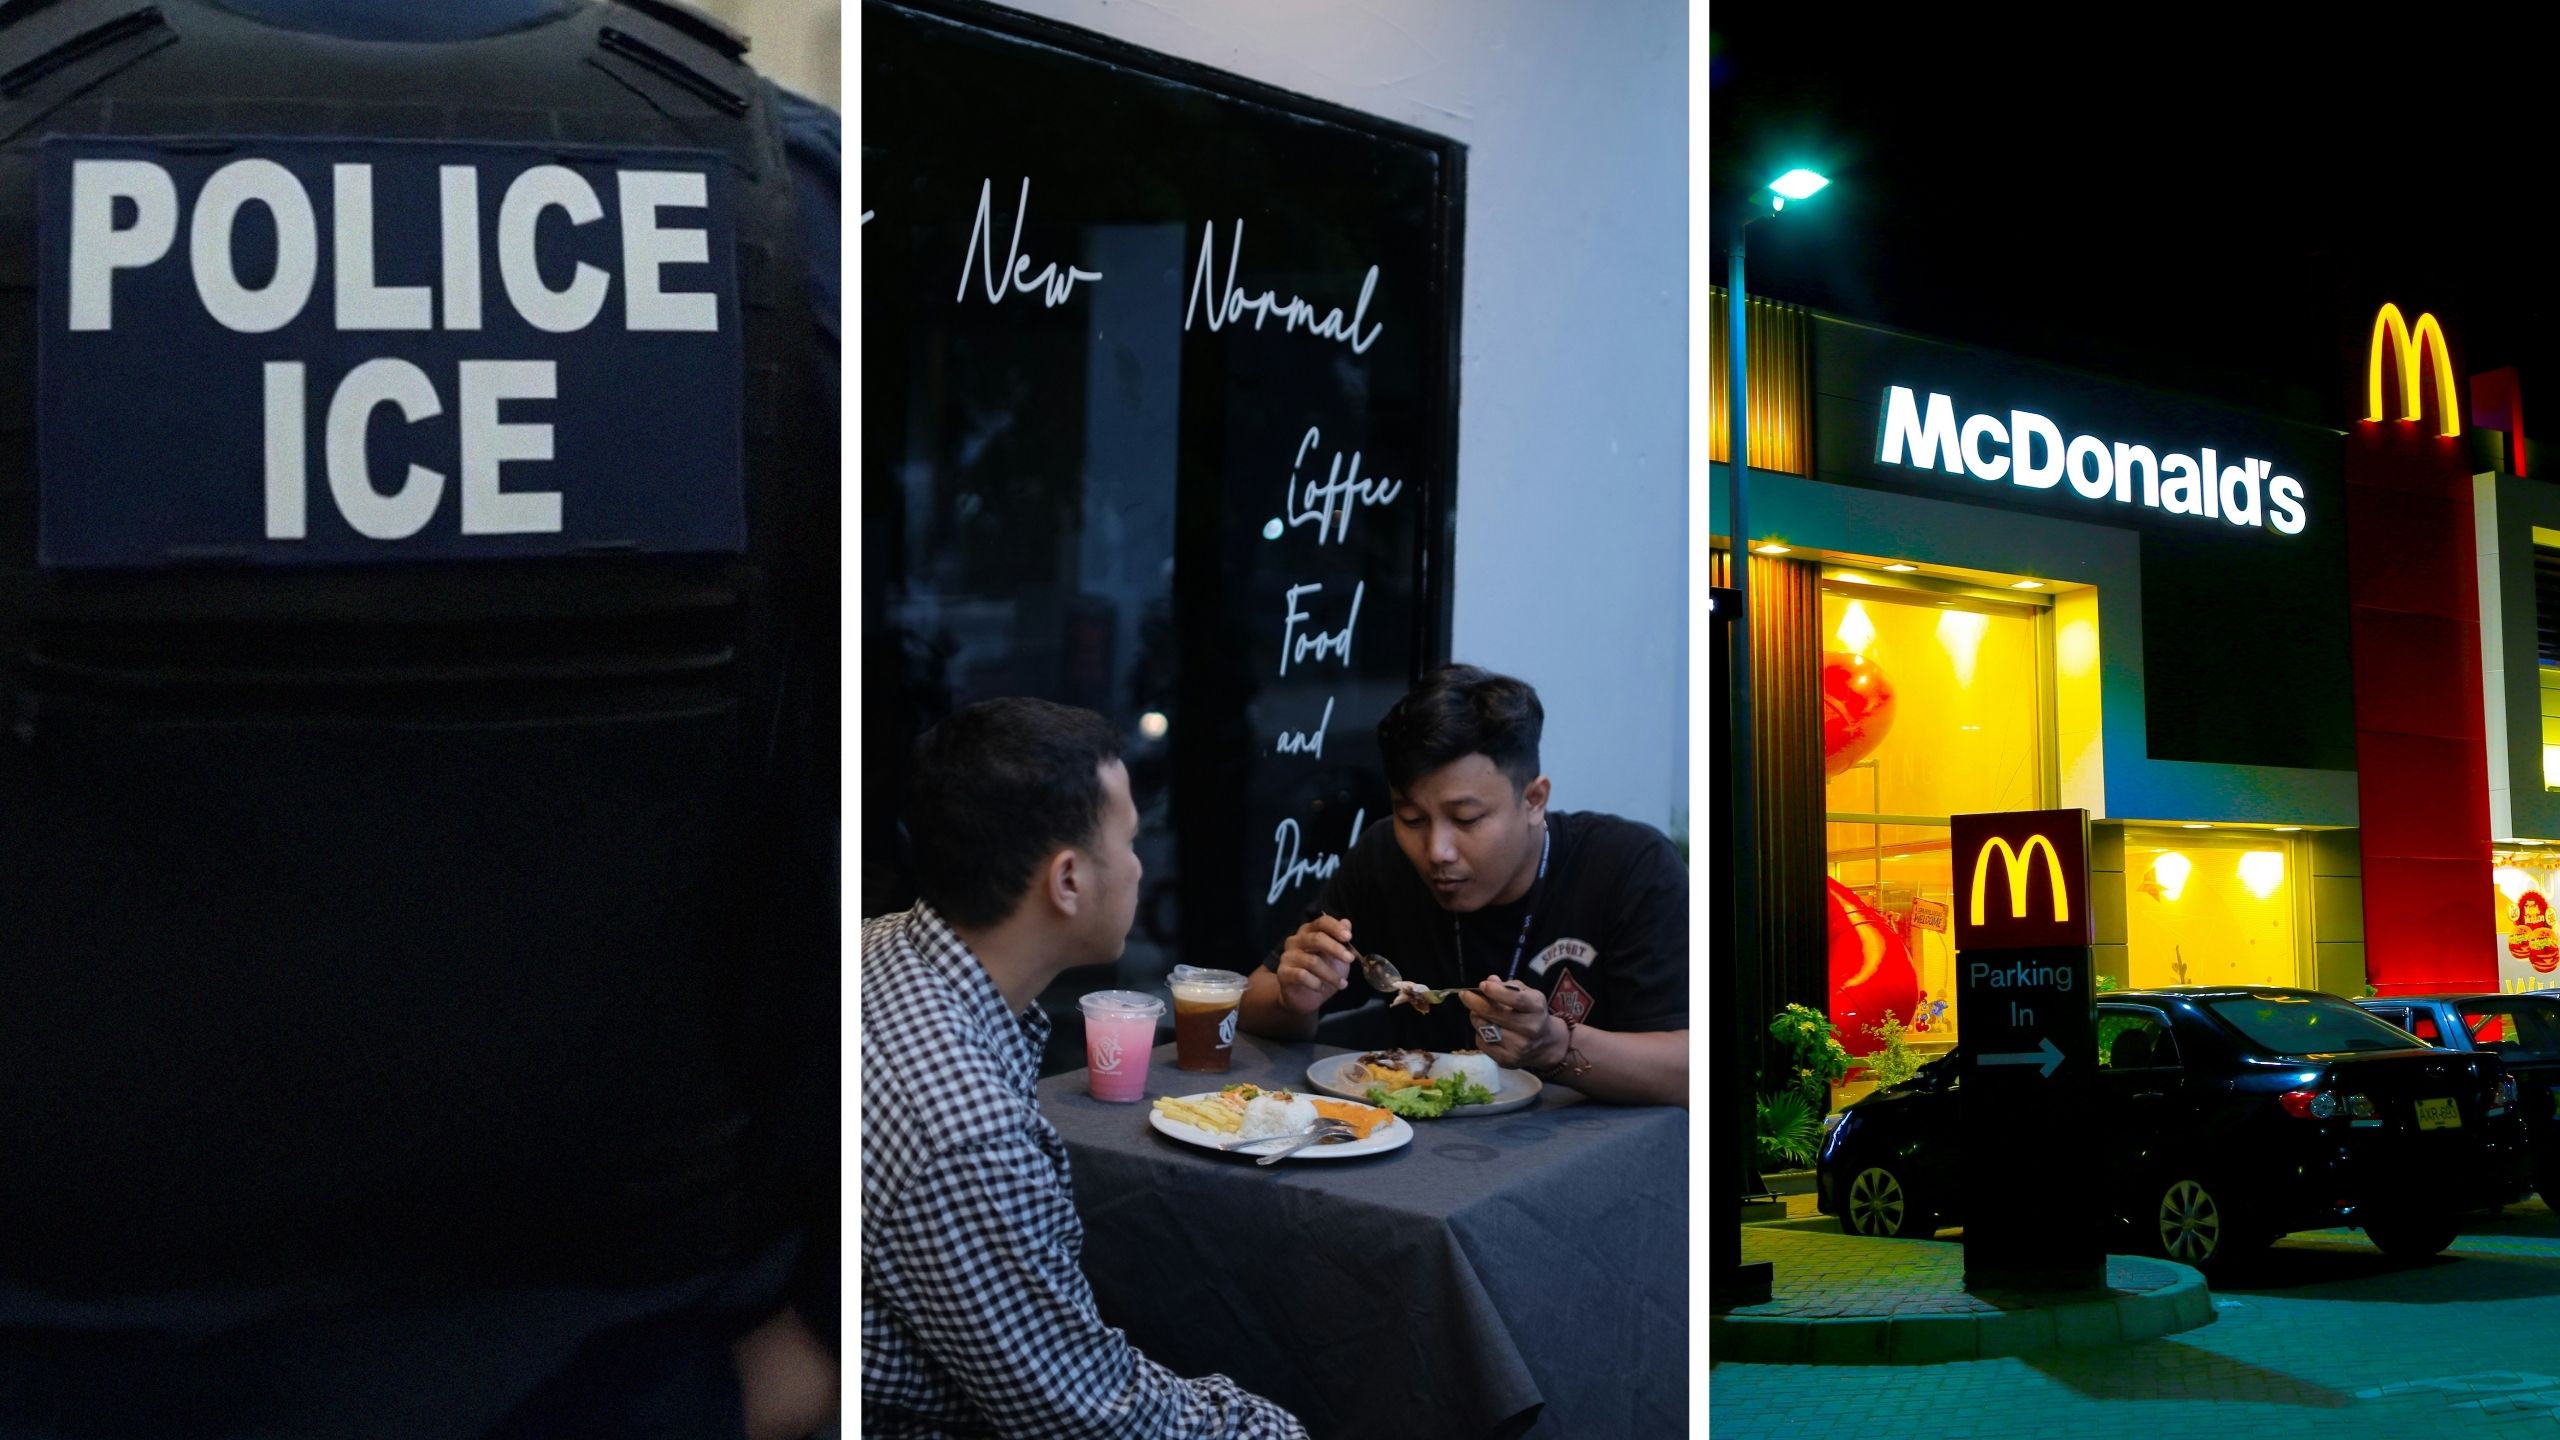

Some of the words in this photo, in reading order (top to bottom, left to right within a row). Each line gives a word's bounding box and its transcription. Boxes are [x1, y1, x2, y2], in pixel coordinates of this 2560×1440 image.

[69, 158, 719, 333] POLICE
[956, 177, 1103, 307] New
[1185, 218, 1383, 354] Normal
[264, 358, 562, 539] ICE
[1287, 426, 1402, 545] Coffee
[1879, 385, 2306, 535] McDonald's
[1279, 580, 1364, 676] Food
[1276, 696, 1335, 760] and
[1541, 942, 1588, 965] SUPPORT
[1970, 960, 2072, 992] Parking
[2011, 1001, 2034, 1027] In
